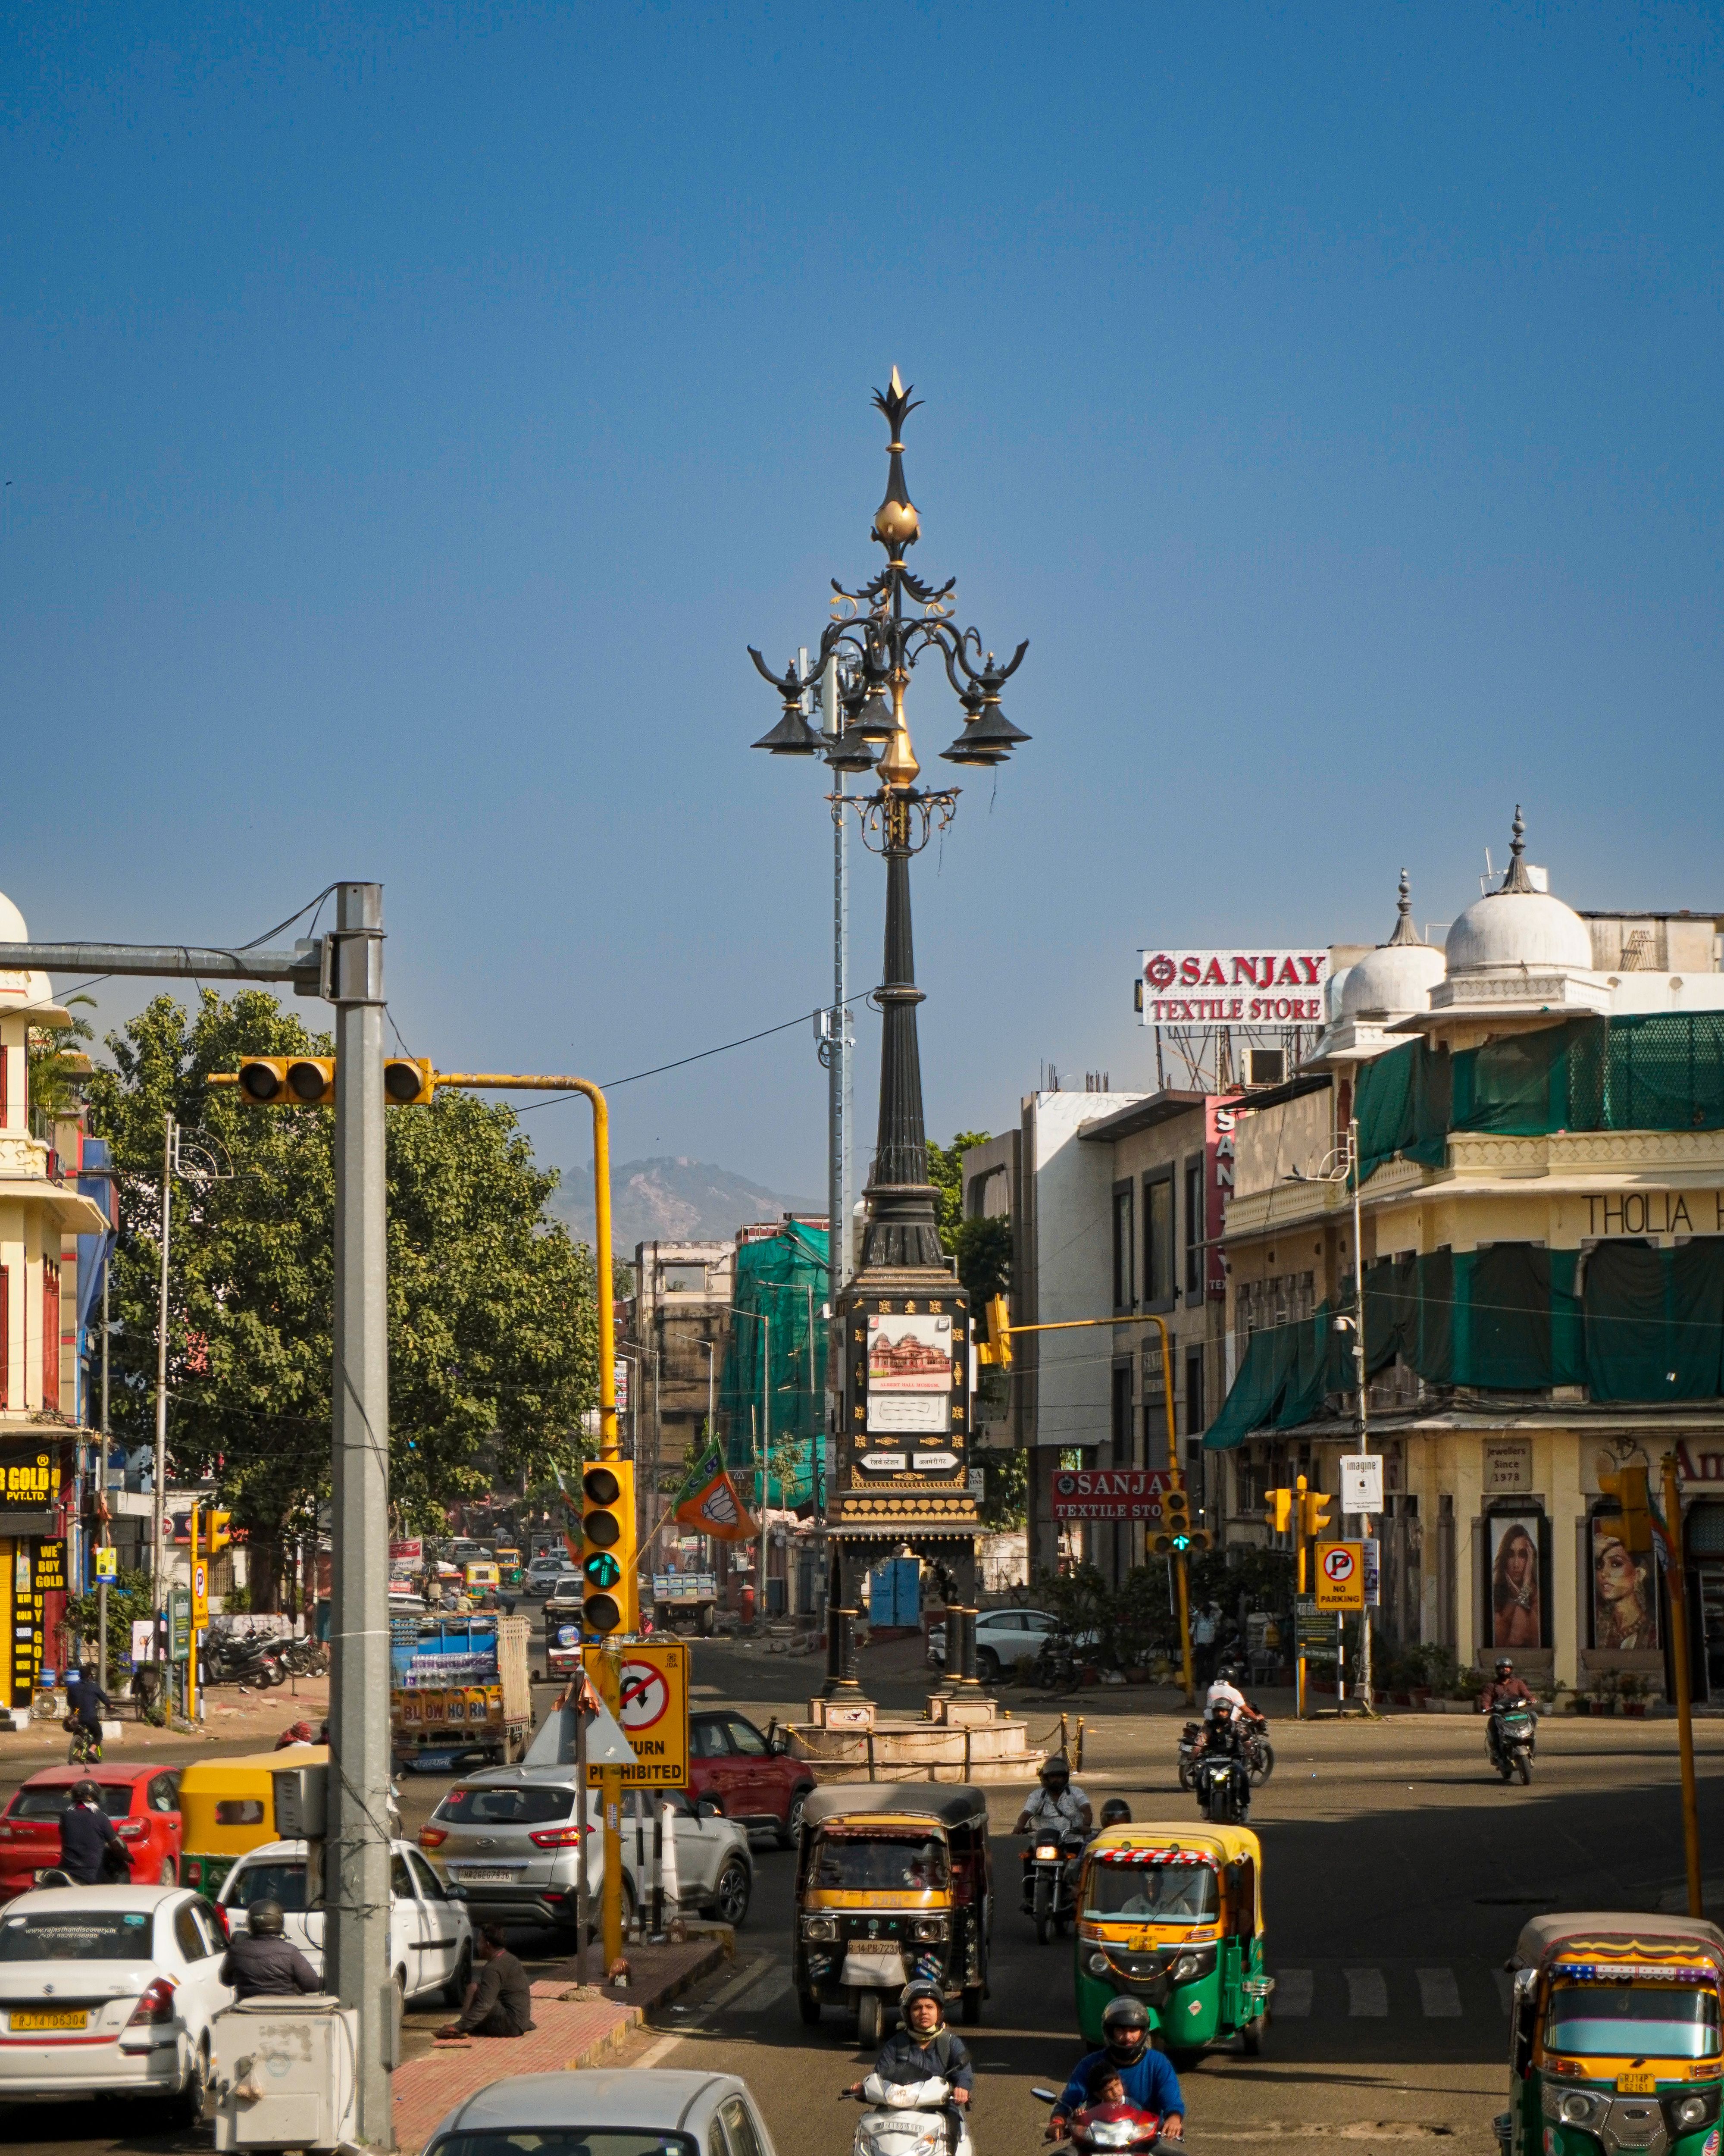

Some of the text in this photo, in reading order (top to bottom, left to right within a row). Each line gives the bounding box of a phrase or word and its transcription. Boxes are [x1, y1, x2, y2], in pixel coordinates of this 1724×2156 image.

[1180, 956, 1326, 990] SANJAY
[1152, 998, 1321, 1020] TEXTILE STORE
[1580, 1193, 1693, 1235] THOLIA
[1346, 1460, 1376, 1473] imagine
[1494, 1460, 1519, 1468] Since
[9, 1467, 49, 1490] GOLD
[1494, 1473, 1520, 1482] 1978
[1056, 1504, 1162, 1517] TEXTILE STO
[41, 1545, 58, 1557] WE
[38, 1560, 59, 1573] BUY
[35, 1575, 63, 1587] GOLD
[16, 1611, 31, 1620] GOLD
[16, 1627, 32, 1637] SILVER
[589, 1764, 681, 1780] PHIBITED
[19, 2014, 85, 2027] RJ14TD6304
[1625, 2074, 1649, 2083] RJ14P
